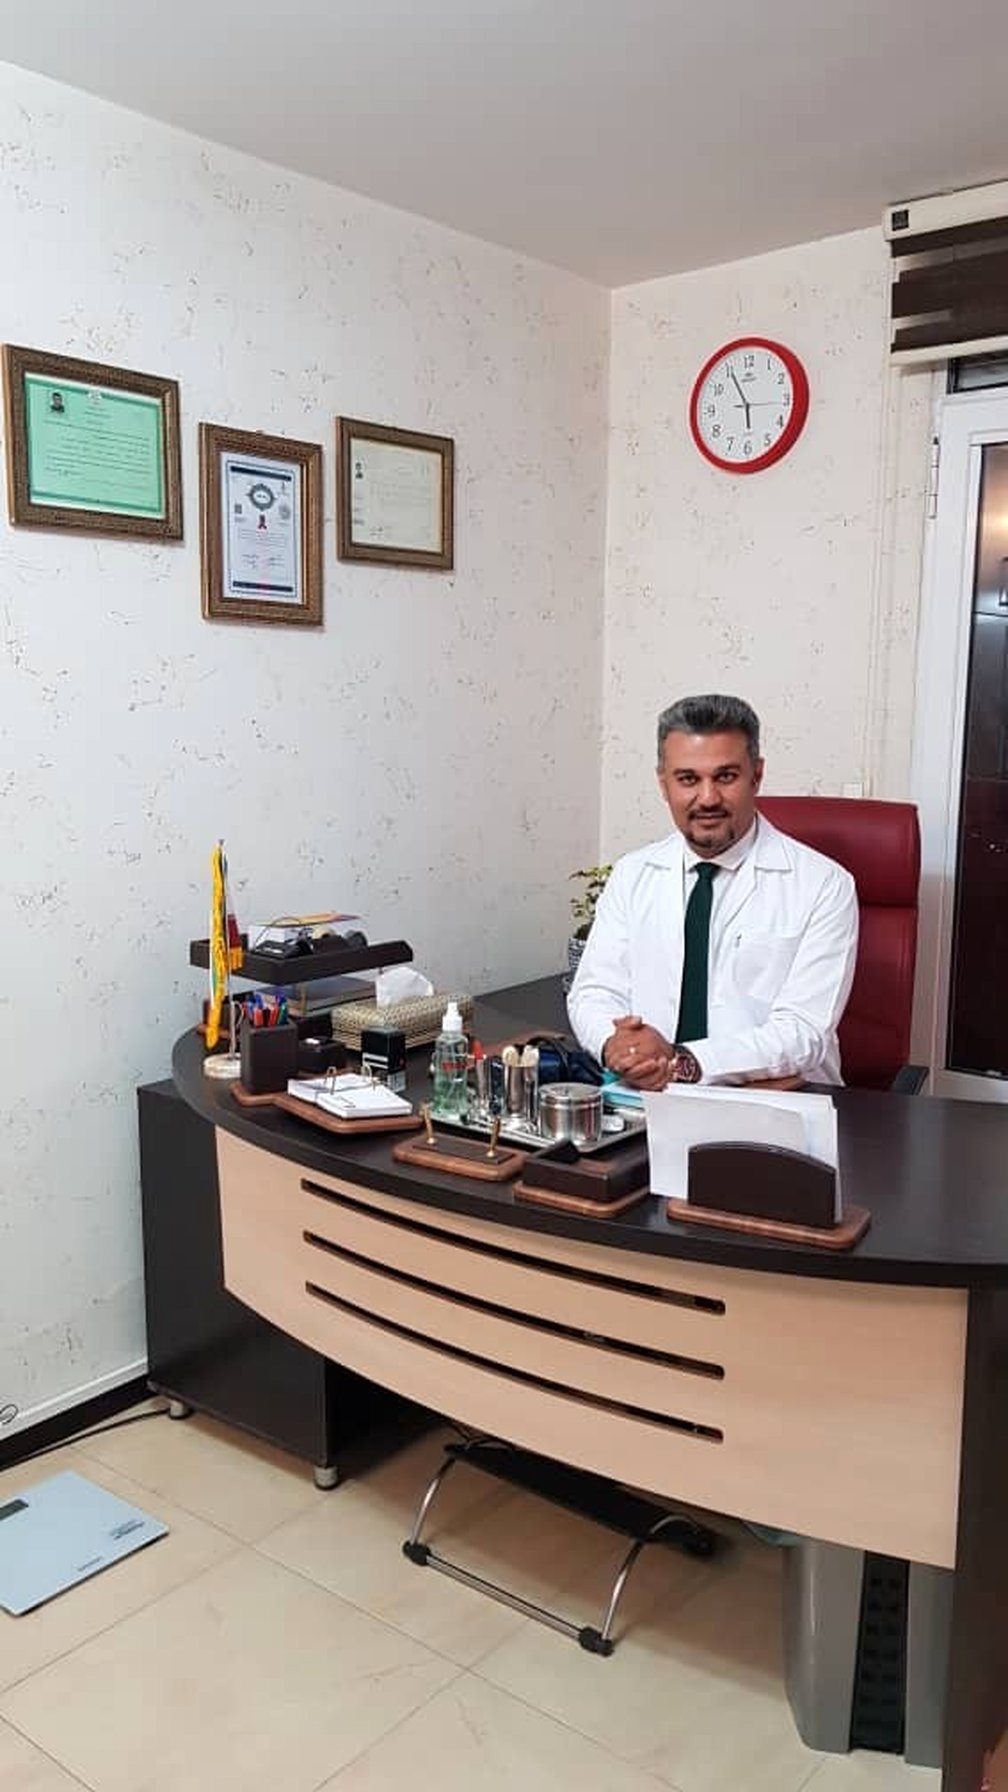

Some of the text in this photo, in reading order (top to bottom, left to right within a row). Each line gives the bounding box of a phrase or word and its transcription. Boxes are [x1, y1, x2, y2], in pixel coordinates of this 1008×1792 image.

[744, 355, 755, 369] 12
[767, 358, 771, 371] 1
[725, 362, 734, 378] 11
[777, 372, 784, 385] 2
[713, 383, 724, 396] 10
[783, 393, 790, 406] 3
[708, 405, 716, 418] 9
[777, 415, 784, 428] 4
[712, 424, 721, 438] 8
[726, 436, 735, 451] 7
[764, 433, 771, 446] 5
[744, 440, 752, 454] 6
